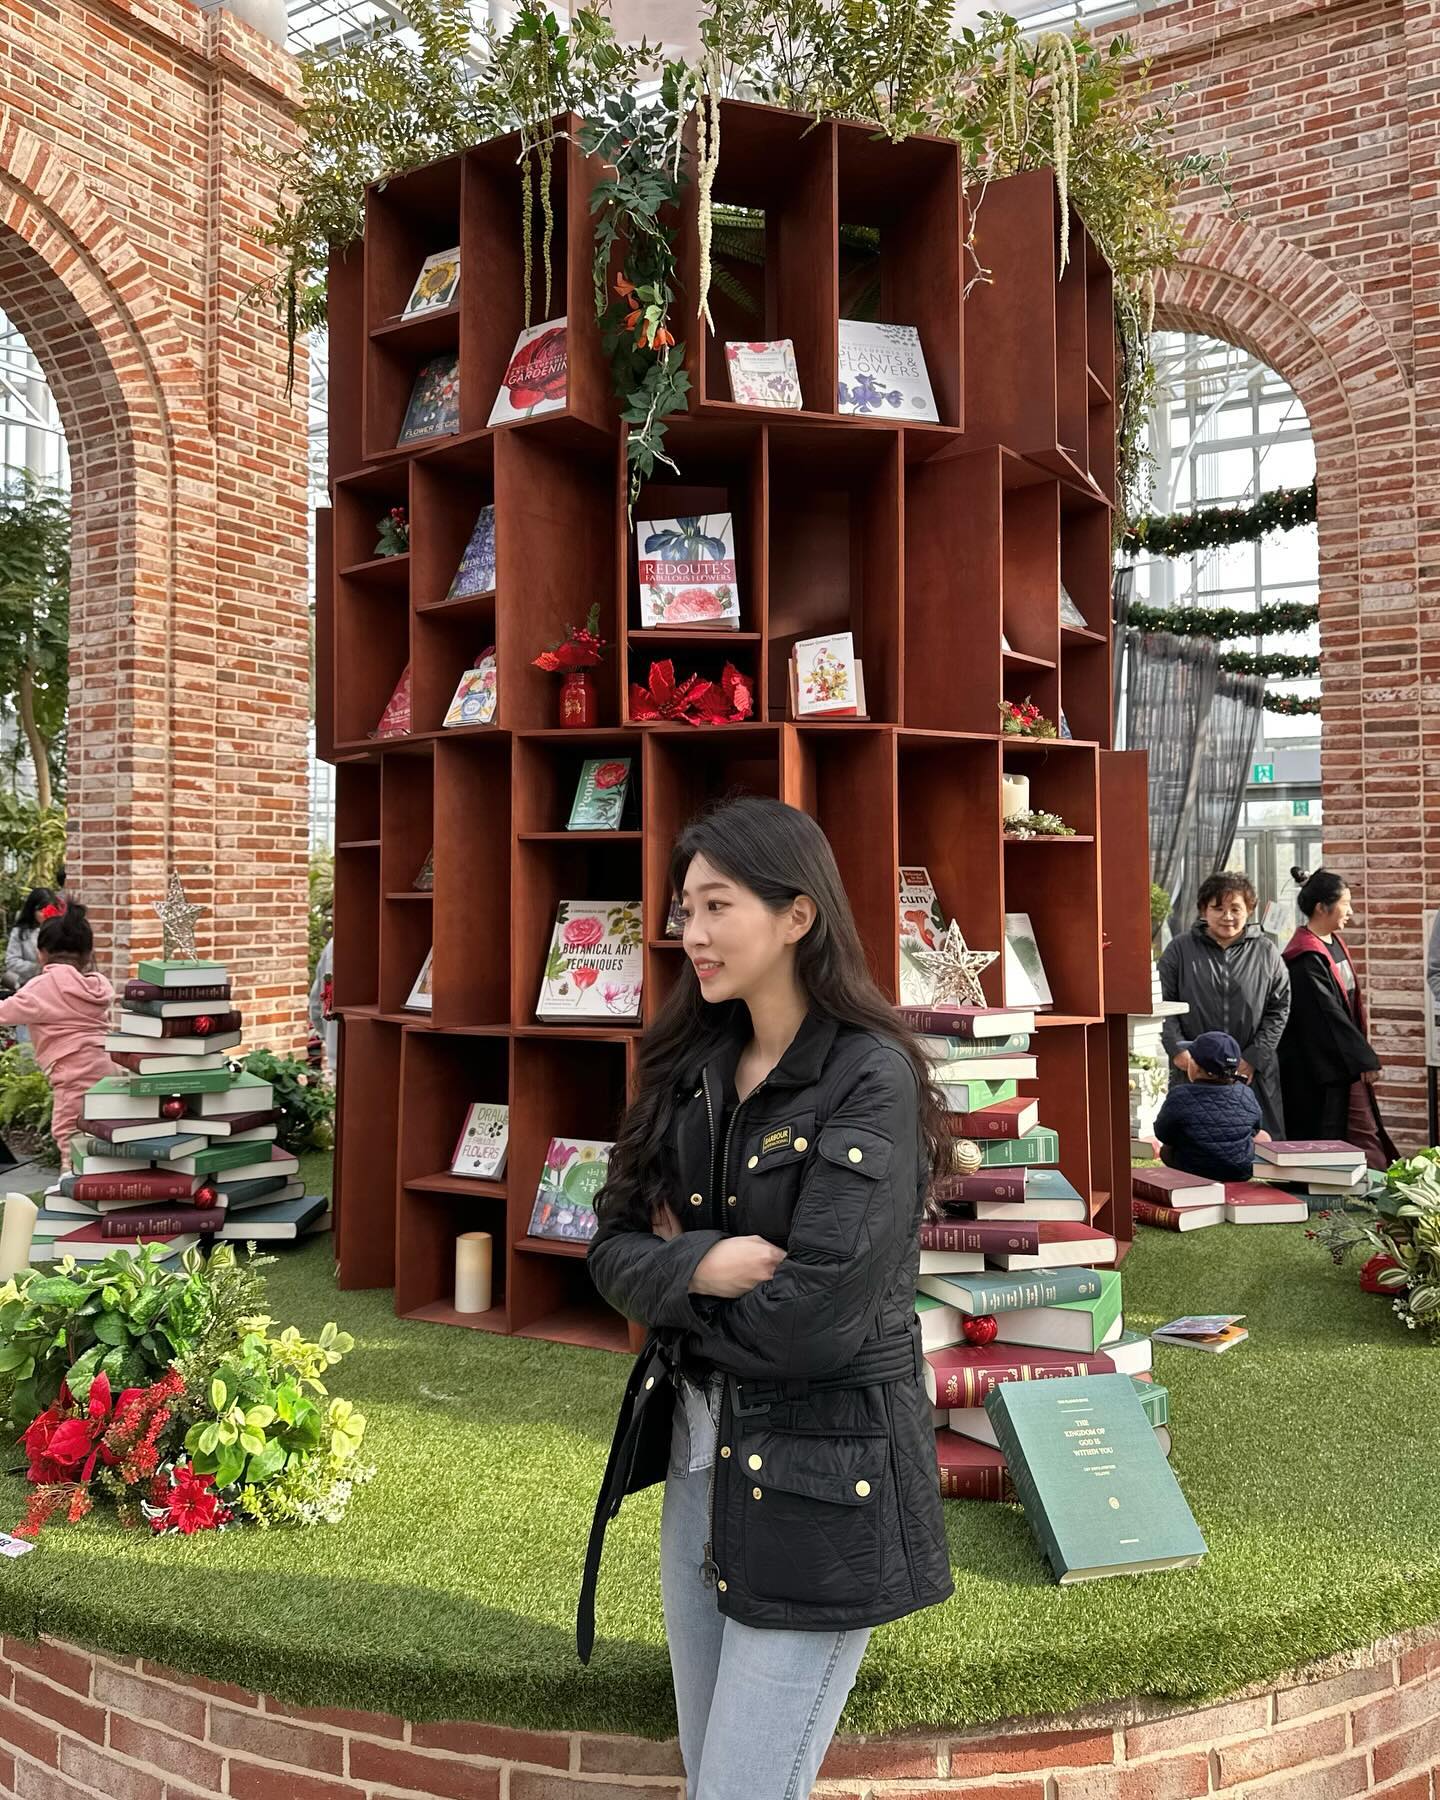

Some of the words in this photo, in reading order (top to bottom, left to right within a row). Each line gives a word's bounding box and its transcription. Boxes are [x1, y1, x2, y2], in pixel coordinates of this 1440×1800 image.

[906, 357, 917, 367] &
[839, 359, 920, 378] FLOWERS
[645, 574, 690, 583] FABULOUS
[692, 574, 732, 582] FLOWERS
[577, 762, 600, 811] Peonies
[562, 943, 612, 955] BOTANICAL
[615, 944, 634, 955] ART
[566, 958, 624, 971] TECHNIQUES
[765, 1130, 788, 1145] BARBOUR
[463, 1145, 500, 1160] FLOWERS
[1074, 1419, 1089, 1427] THE
[1063, 1428, 1097, 1437] KINGDOM
[1096, 1427, 1105, 1435] OF
[1078, 1438, 1094, 1446] GOD
[1094, 1437, 1101, 1445] IS
[1072, 1447, 1100, 1457] WITHIN
[1099, 1446, 1114, 1455] YOU
